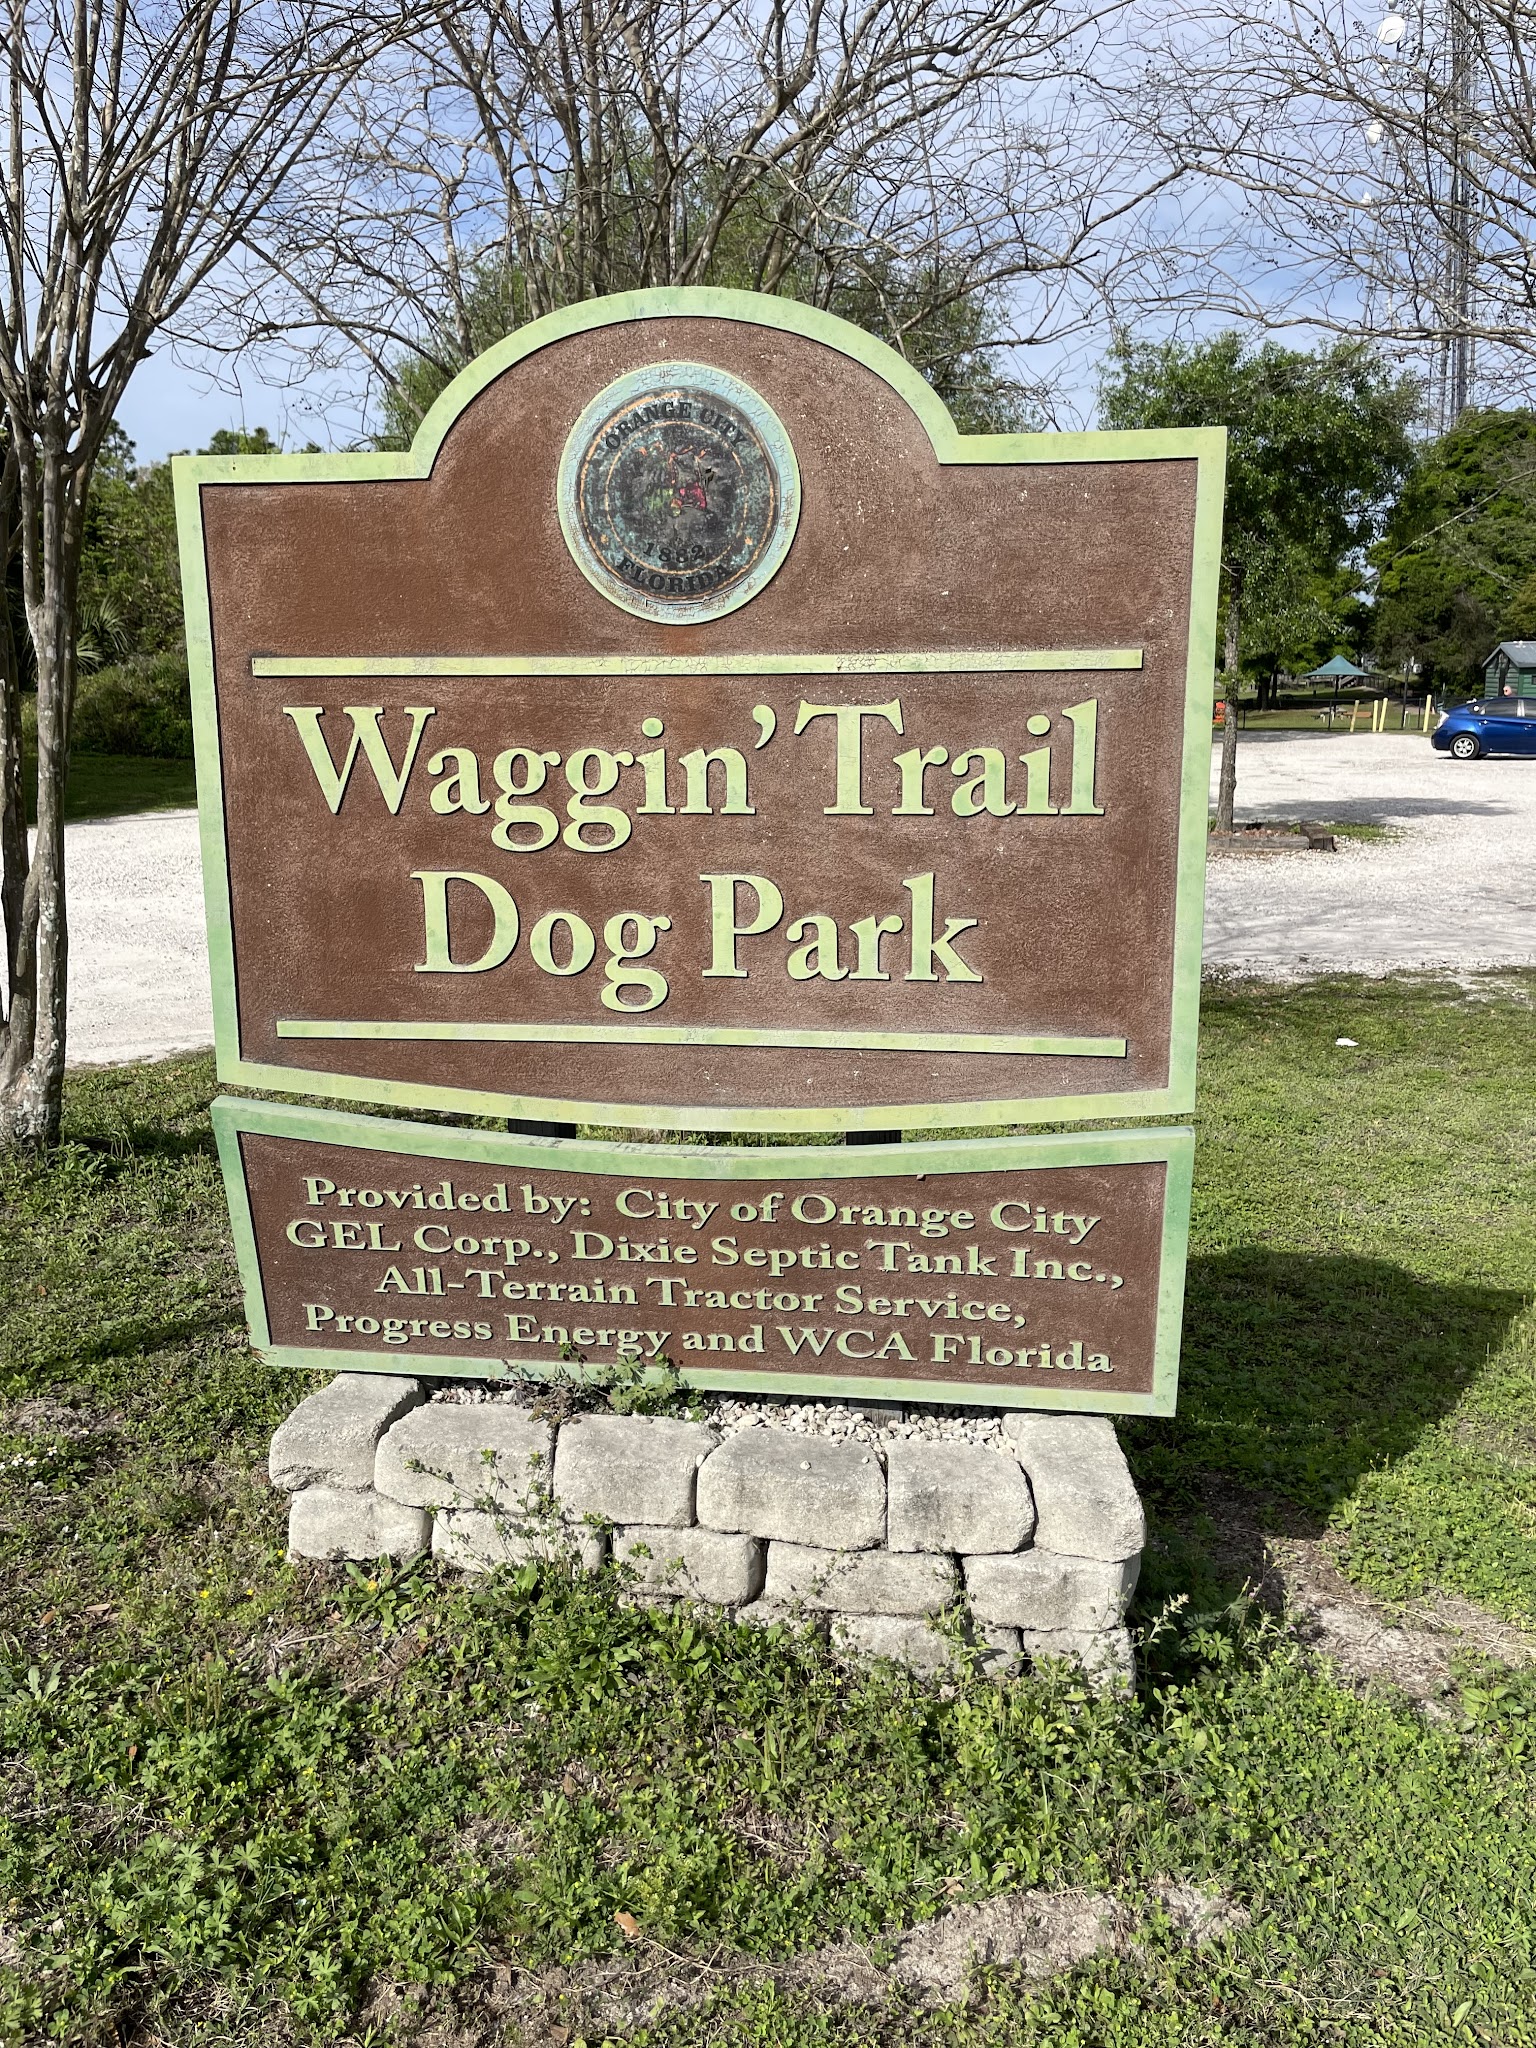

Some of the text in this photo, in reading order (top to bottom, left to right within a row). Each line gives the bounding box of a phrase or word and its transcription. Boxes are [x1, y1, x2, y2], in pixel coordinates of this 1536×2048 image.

[605, 401, 748, 450] ORANGE CITY
[616, 558, 733, 593] FLORIDA
[643, 542, 706, 564] 1882
[283, 699, 1104, 852] Waggin' Trail
[410, 871, 983, 1013] Dog Park
[302, 1176, 1102, 1245] Provided by: City of Orange City
[286, 1218, 1125, 1290] GEL Corp., Dixie Septic Tank Inc.,
[374, 1265, 1027, 1329] All-Terrain Tractor Service,
[302, 1303, 1114, 1374] Progress Energy and WCA Florida
